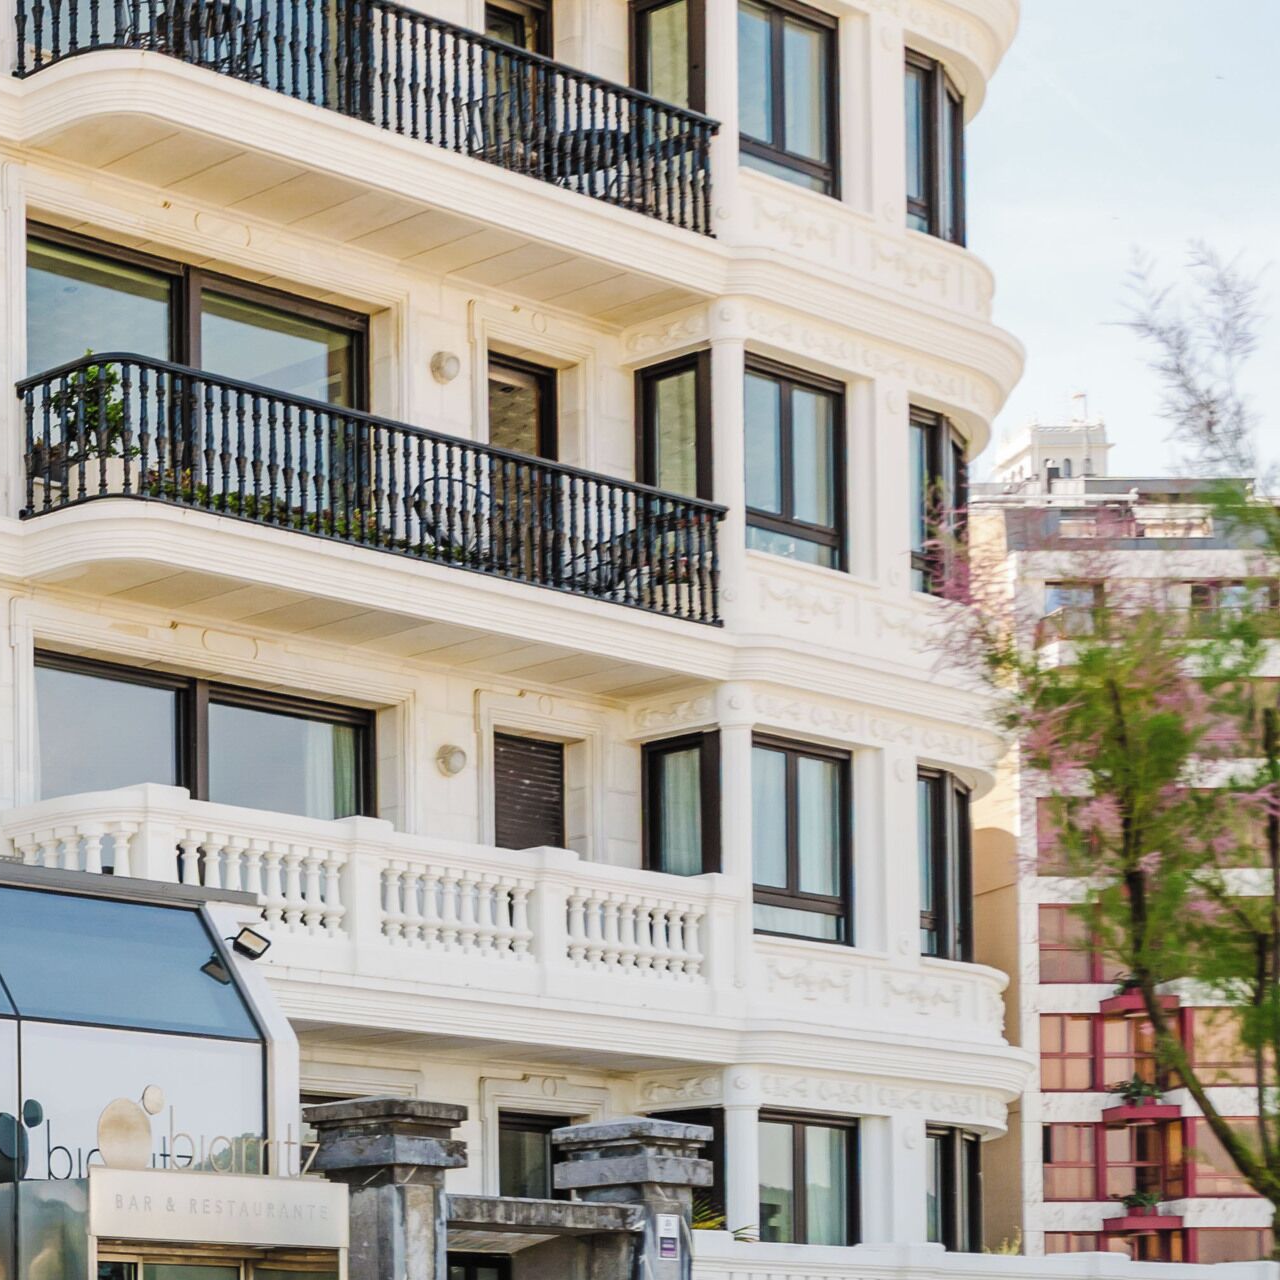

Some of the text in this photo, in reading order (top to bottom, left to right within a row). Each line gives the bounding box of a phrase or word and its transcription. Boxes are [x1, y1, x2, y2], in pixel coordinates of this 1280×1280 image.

[115, 1194, 329, 1220] BAR & RESTAURANTE
